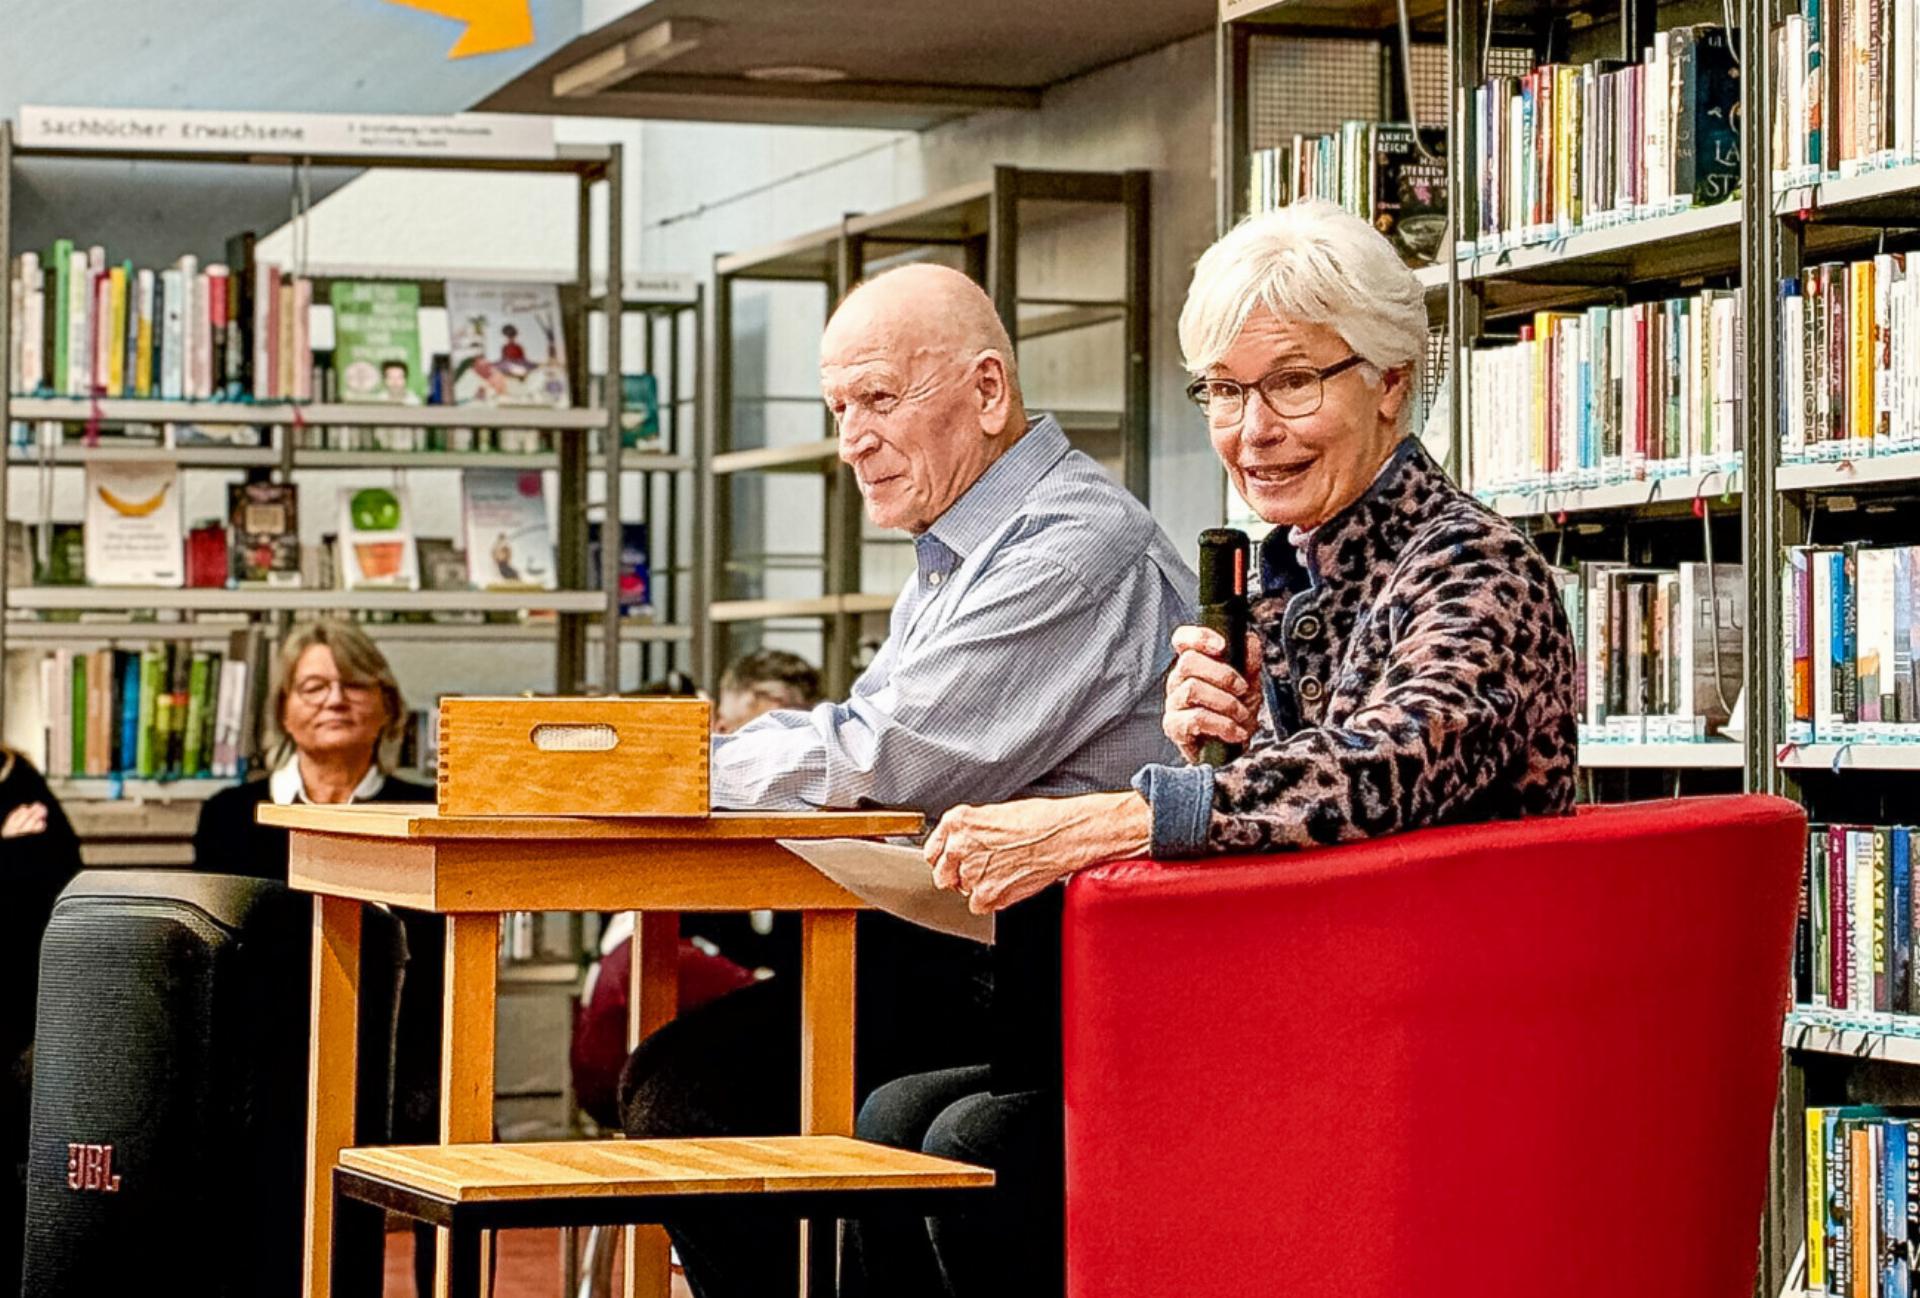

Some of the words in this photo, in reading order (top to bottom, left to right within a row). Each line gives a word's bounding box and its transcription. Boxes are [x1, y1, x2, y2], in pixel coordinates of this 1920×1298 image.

[41, 119, 166, 137] Sachbücher
[181, 122, 306, 143] Erwachsene
[1377, 142, 1408, 153] REICH
[1400, 165, 1444, 176] STERBEN
[1408, 176, 1430, 187] UNS
[1874, 832, 1884, 910] OKAYE
[1874, 915, 1884, 973] TAGE
[67, 1142, 121, 1193] JBL
[1908, 1201, 1918, 1223] JO
